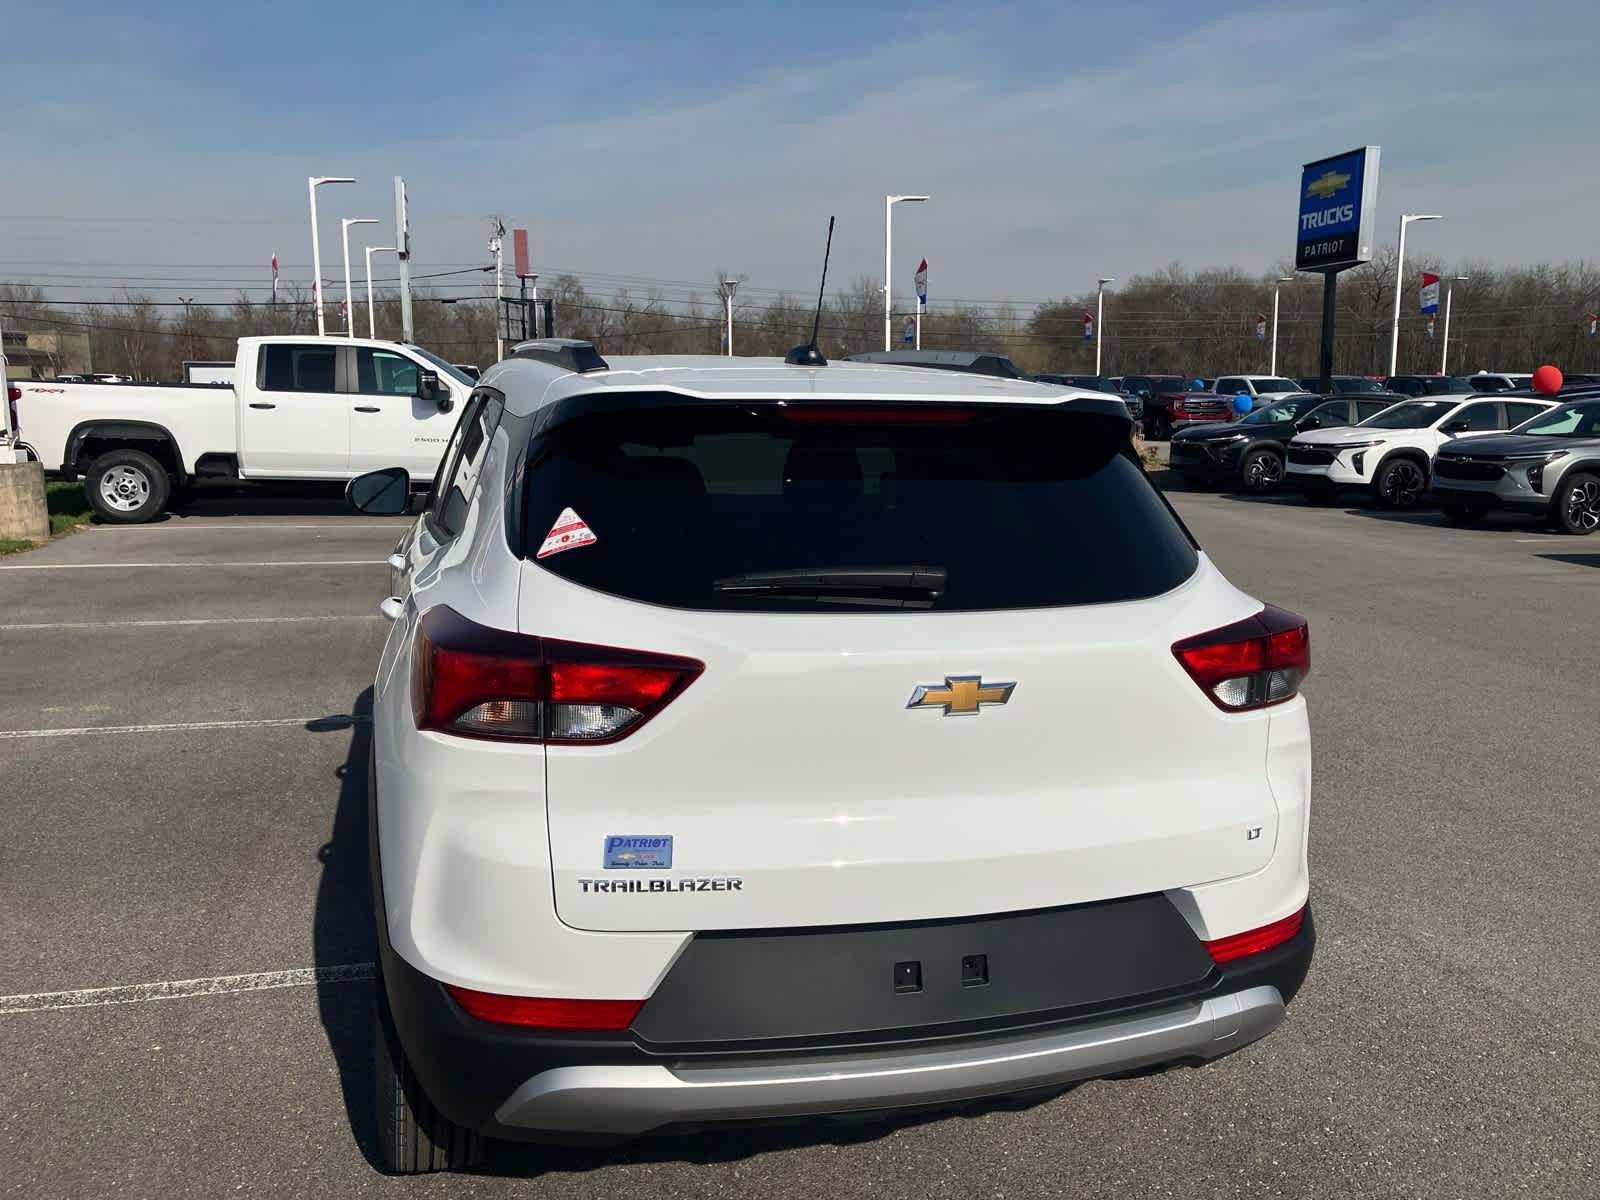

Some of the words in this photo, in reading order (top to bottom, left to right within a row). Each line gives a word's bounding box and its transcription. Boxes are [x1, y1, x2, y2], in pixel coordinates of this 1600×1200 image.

[1301, 204, 1354, 231] TRUCKS
[1304, 239, 1345, 257] PATRIOT
[1247, 826, 1264, 841] LT
[577, 876, 744, 893] TRAILBLAZER
